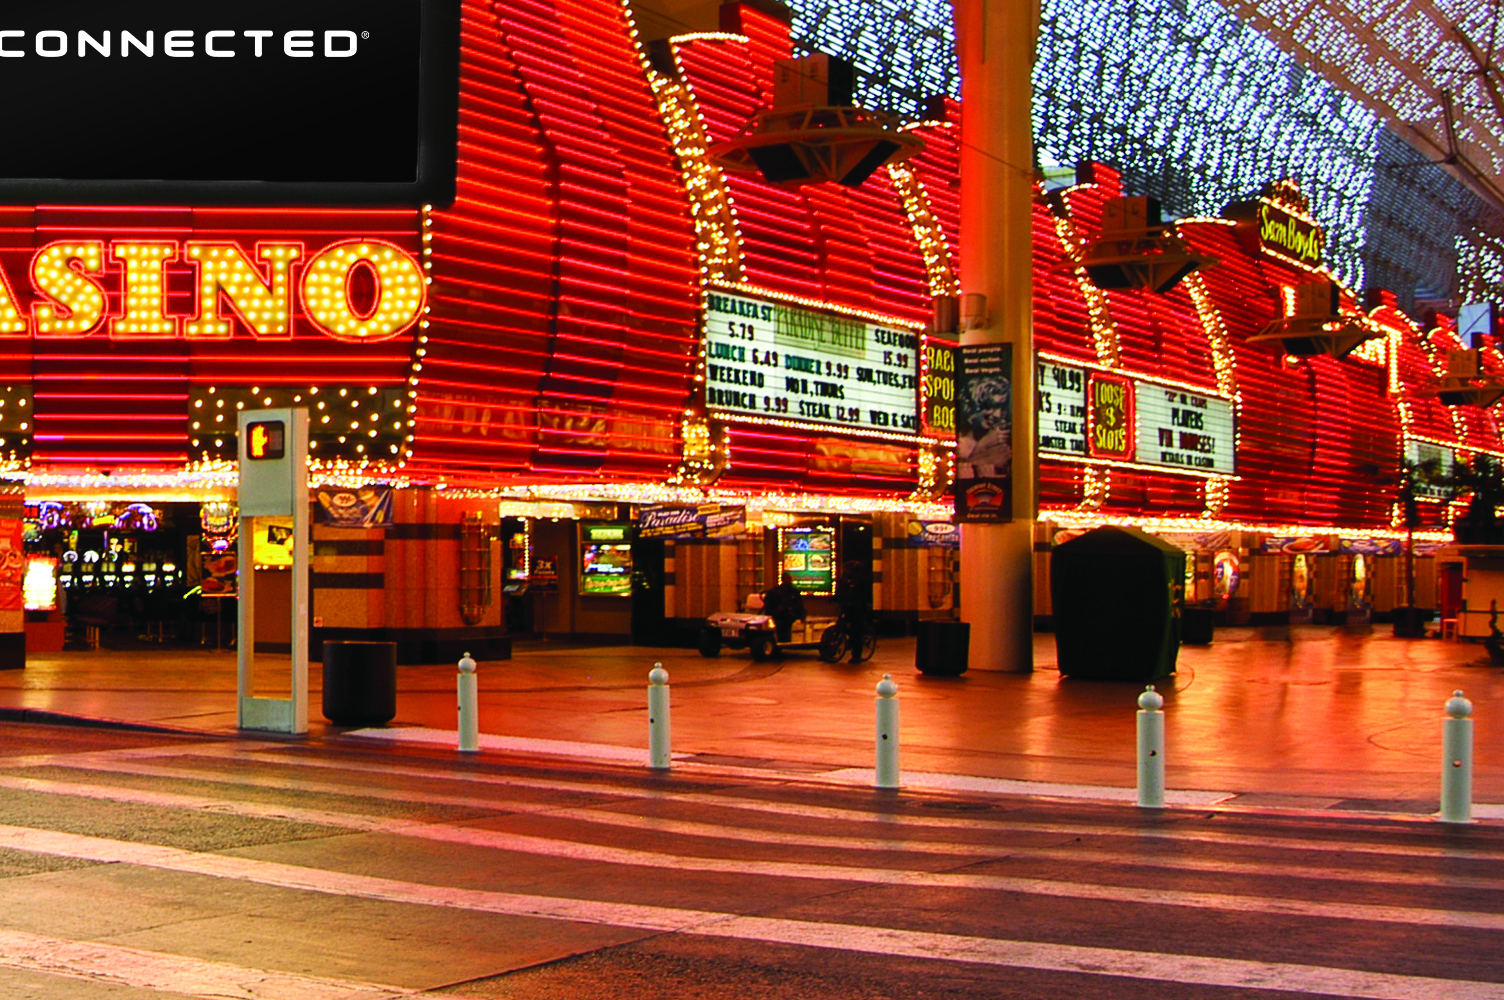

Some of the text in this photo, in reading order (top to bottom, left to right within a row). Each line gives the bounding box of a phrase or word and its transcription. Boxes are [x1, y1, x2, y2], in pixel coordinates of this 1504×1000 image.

[1260, 204, 1287, 248] Sam
[708, 295, 773, 322] BREAKFAST
[728, 321, 909, 368] 5.79 15.99
[708, 341, 746, 363] LUNCH
[752, 348, 779, 367] 6.49
[784, 353, 822, 376] DINNER
[826, 360, 850, 379] 9.99
[708, 363, 765, 388] WEEKEND
[925, 374, 955, 402] SPO
[707, 386, 757, 410] BRUNCH
[763, 395, 789, 414] 9.99
[799, 400, 832, 420] STEAK
[836, 405, 860, 422] 12.99
[1095, 382, 1126, 413] LOOSE
[1054, 419, 1078, 434] STEAK
[1172, 407, 1203, 431] PLAYERS
[1096, 423, 1126, 452] SLOTS
[639, 509, 700, 529] Paradise
